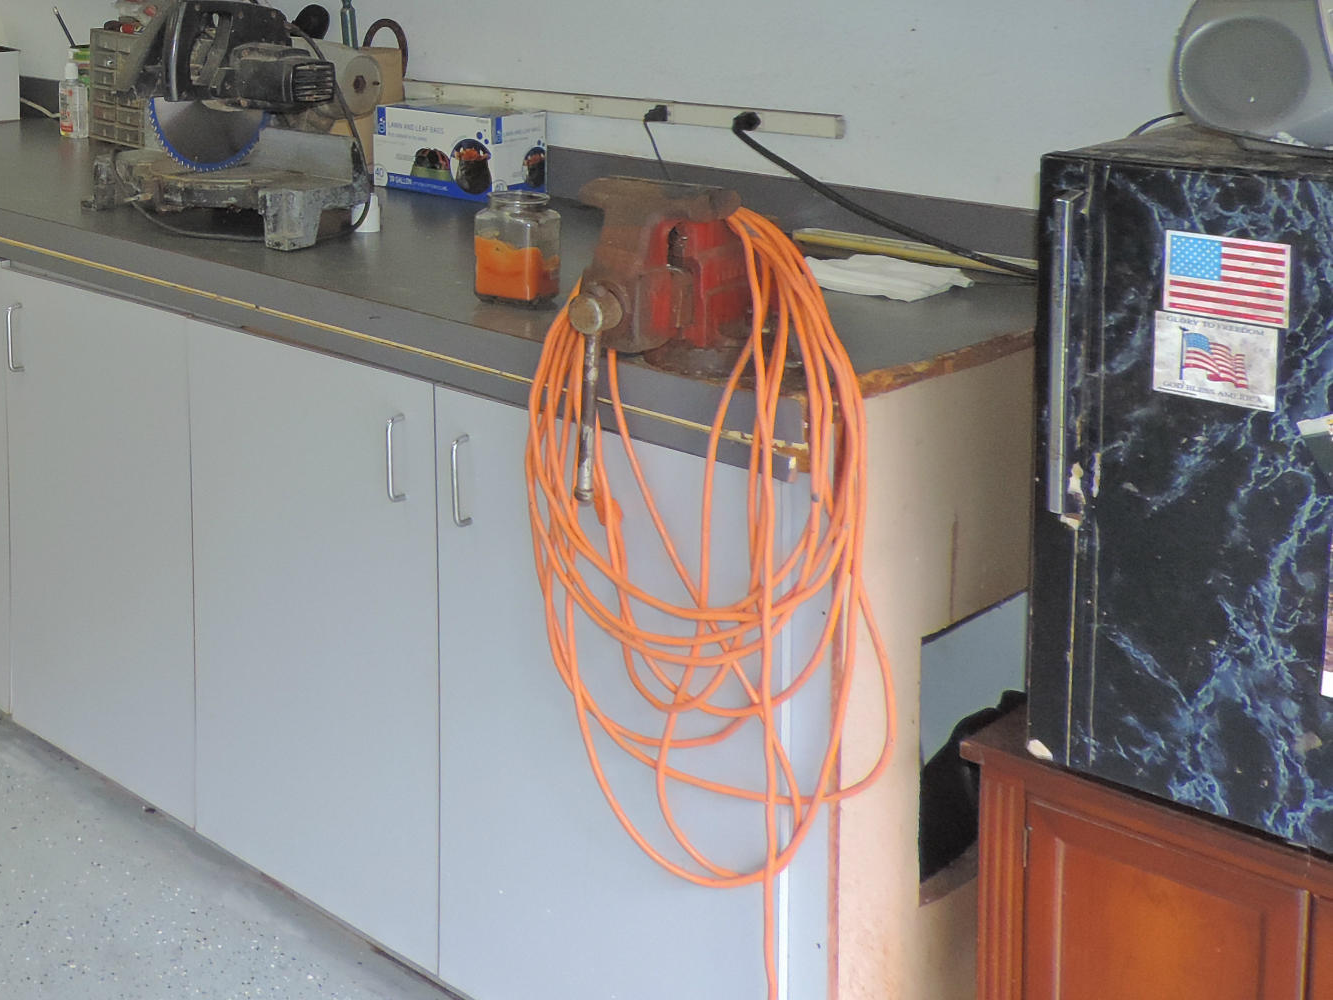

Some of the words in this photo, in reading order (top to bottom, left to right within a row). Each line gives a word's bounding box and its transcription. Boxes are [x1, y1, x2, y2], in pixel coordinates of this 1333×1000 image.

[375, 167, 384, 178] 40
[1166, 315, 1198, 326] GLORY
[1203, 320, 1215, 328] TO
[1216, 323, 1265, 336] FREEDOM
[1163, 381, 1184, 389] GOD
[1185, 385, 1215, 394] BLESS
[1218, 391, 1263, 403] AMERICA
